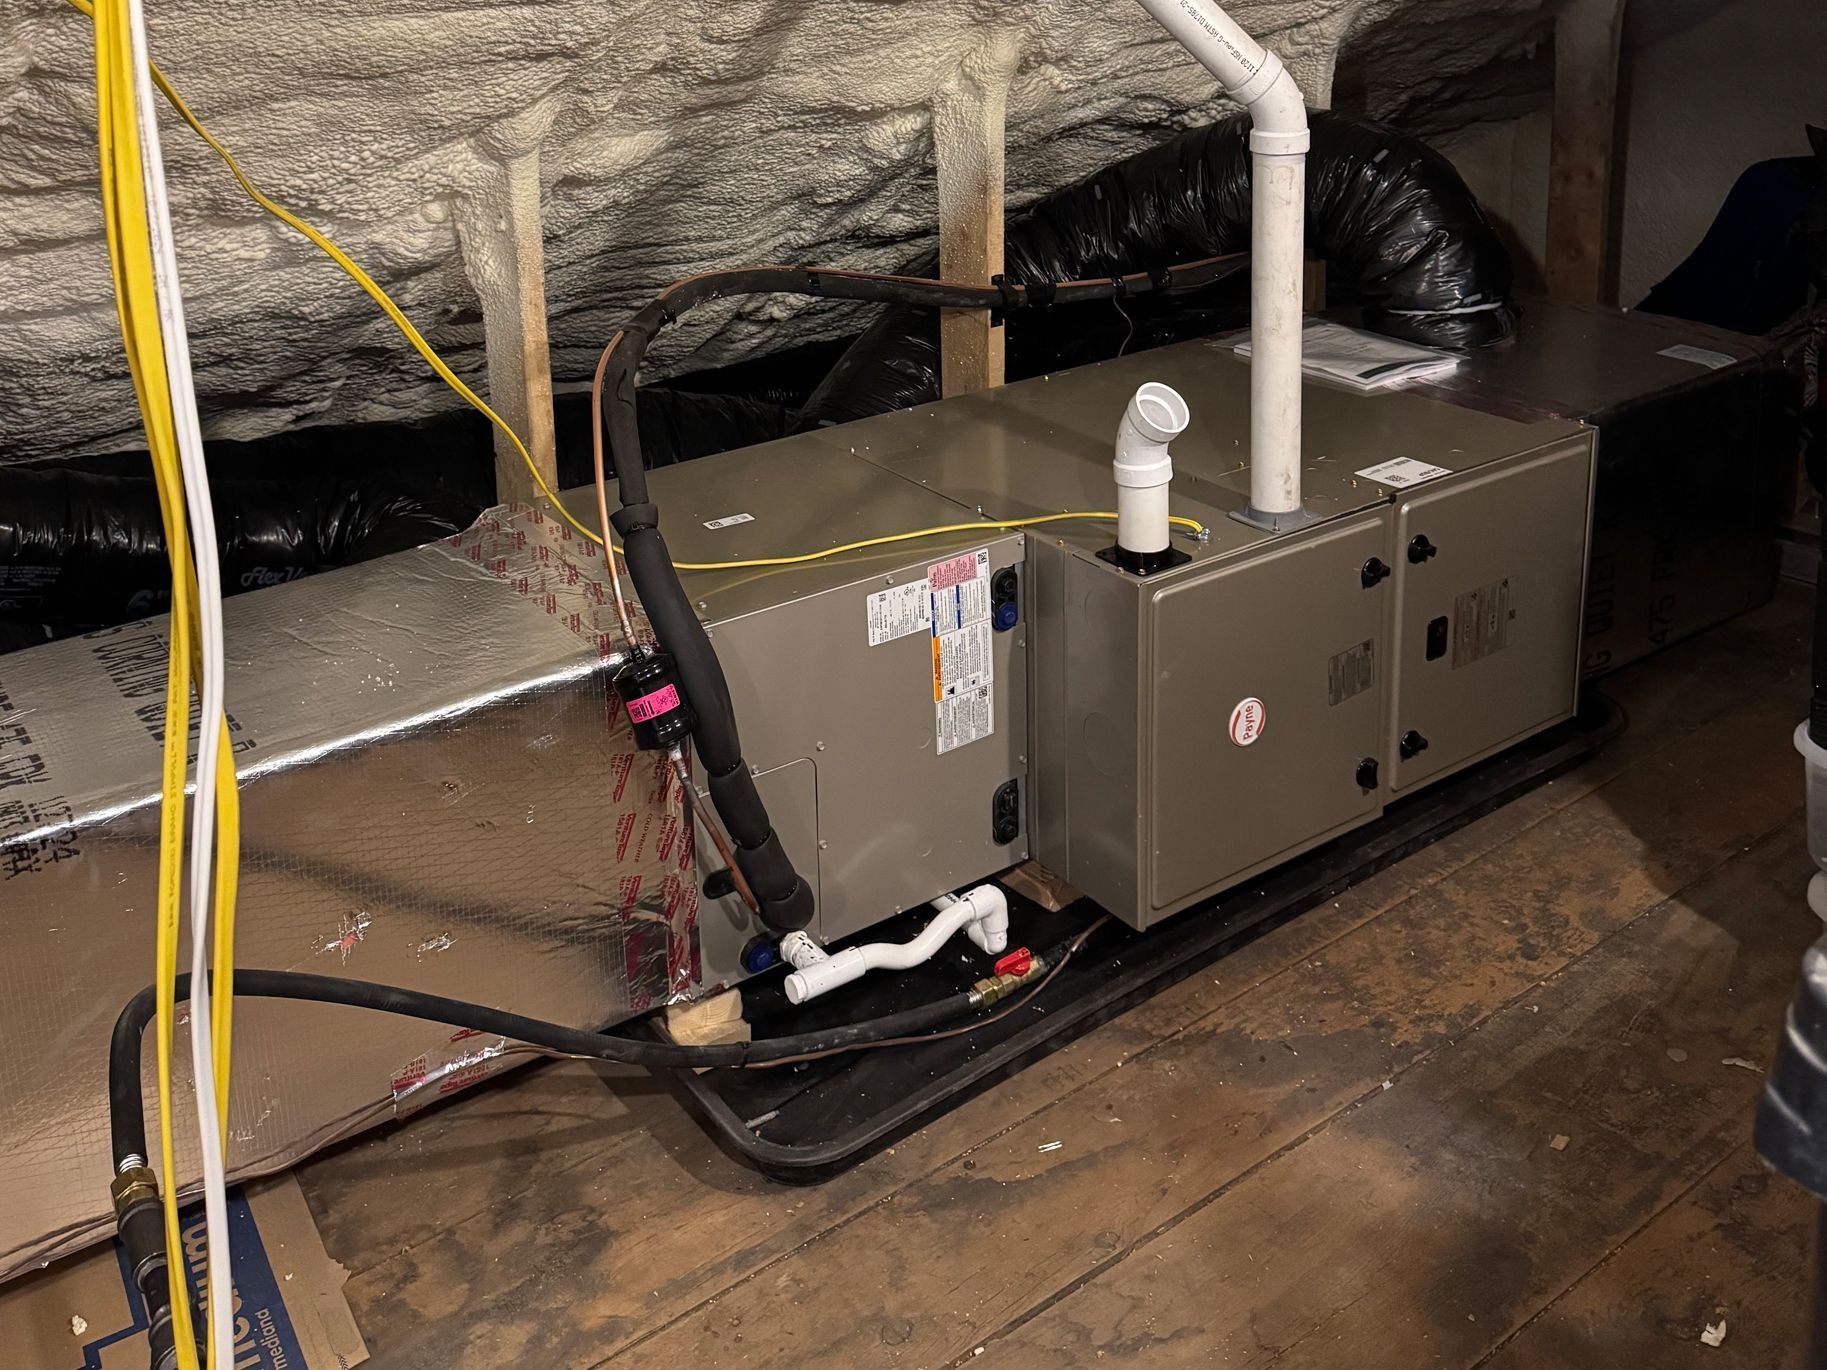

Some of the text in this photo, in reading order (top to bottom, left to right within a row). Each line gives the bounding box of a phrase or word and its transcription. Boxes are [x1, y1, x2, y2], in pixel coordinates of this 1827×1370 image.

[240, 566, 285, 588] Flex
[1648, 594, 1675, 644] 475
[1243, 705, 1256, 740] Payne
